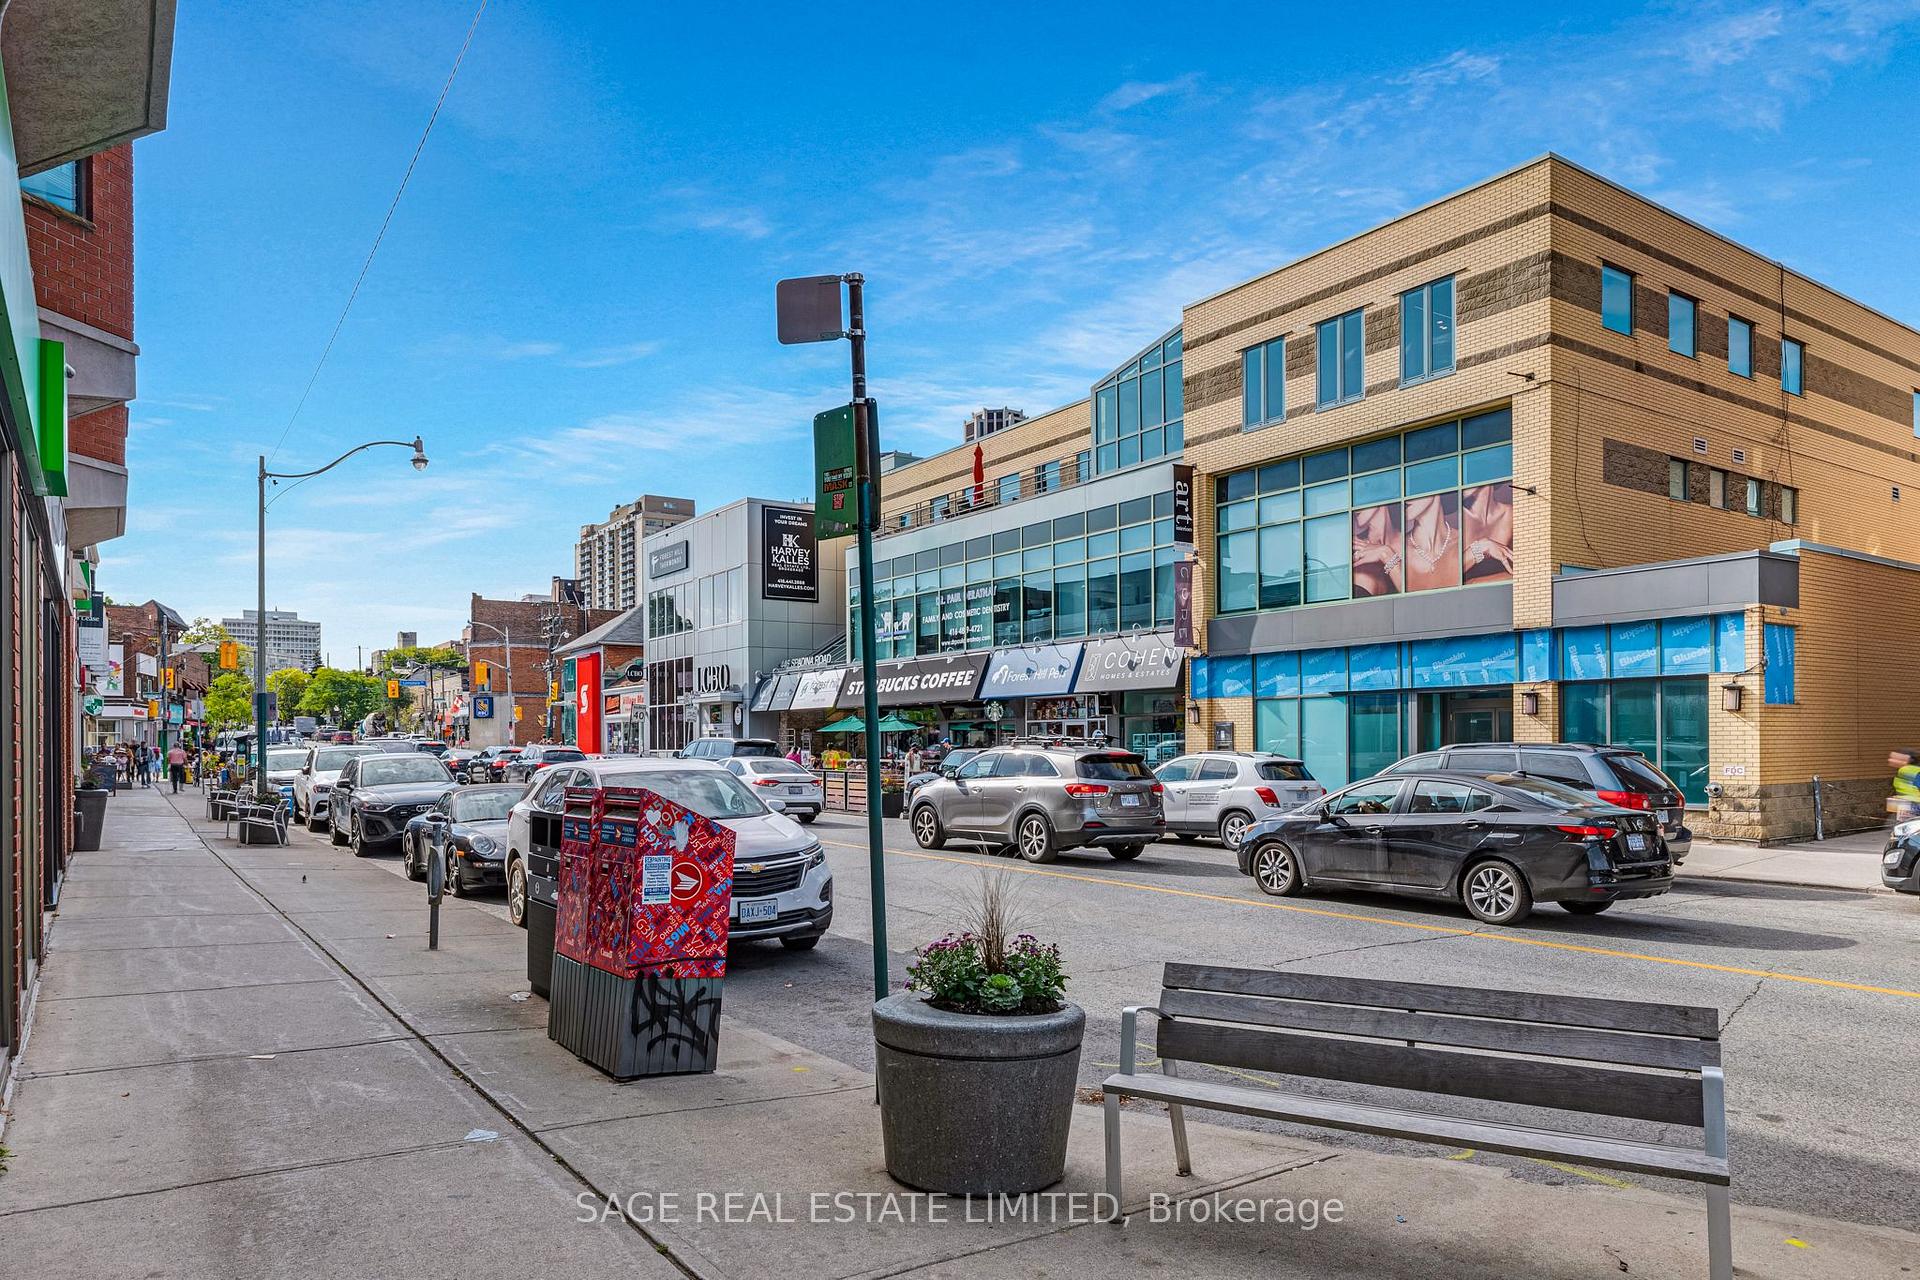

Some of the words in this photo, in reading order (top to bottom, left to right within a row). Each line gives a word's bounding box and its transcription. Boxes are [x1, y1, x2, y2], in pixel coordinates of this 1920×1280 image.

[1176, 480, 1193, 525] art
[771, 546, 811, 558] HARVEY
[772, 554, 810, 566] KALLES
[768, 583, 815, 592] HARVEYKALLES.COM
[941, 612, 954, 622] AND
[791, 656, 815, 668] SPADINA
[815, 654, 832, 665] ROAD
[1104, 648, 1178, 670] COHEN
[1432, 651, 1466, 670] Blueskin
[627, 669, 643, 677] LCBO
[697, 664, 731, 693] LCBO
[1033, 667, 1047, 681] Hill
[1100, 672, 1127, 681] HOMES
[1134, 669, 1170, 679] ESTATES
[847, 675, 921, 696] STABUCKS
[920, 669, 976, 690] COFFEE
[633, 711, 645, 720] 40
[1724, 766, 1744, 776] FDC
[640, 824, 663, 850] H9X
[636, 919, 658, 943] G3N
[665, 922, 690, 948] M6S
